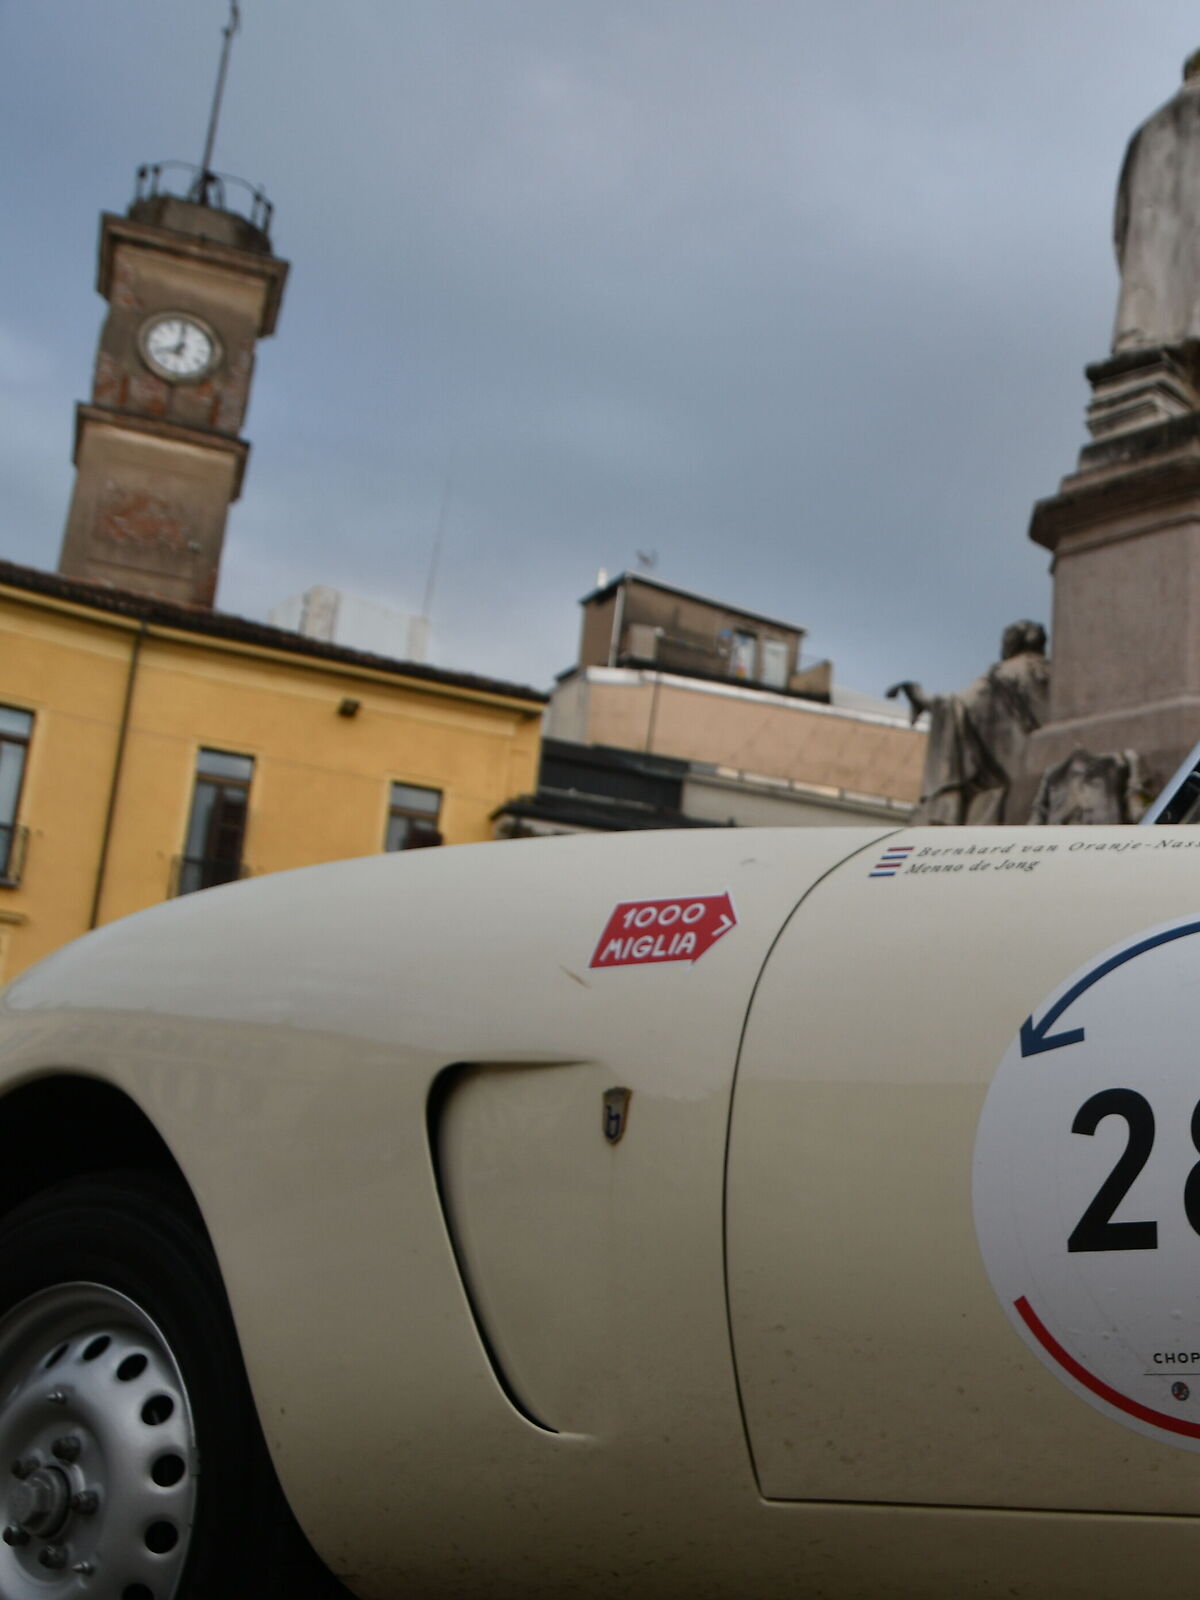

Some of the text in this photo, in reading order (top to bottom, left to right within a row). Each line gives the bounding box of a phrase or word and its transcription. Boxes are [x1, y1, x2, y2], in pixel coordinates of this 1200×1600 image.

[917, 843, 1017, 857] Bernhard
[1021, 844, 1059, 853] van
[904, 859, 1041, 875] Menno de Jong
[623, 902, 706, 929] 1000
[599, 931, 698, 962] MIGLIA
